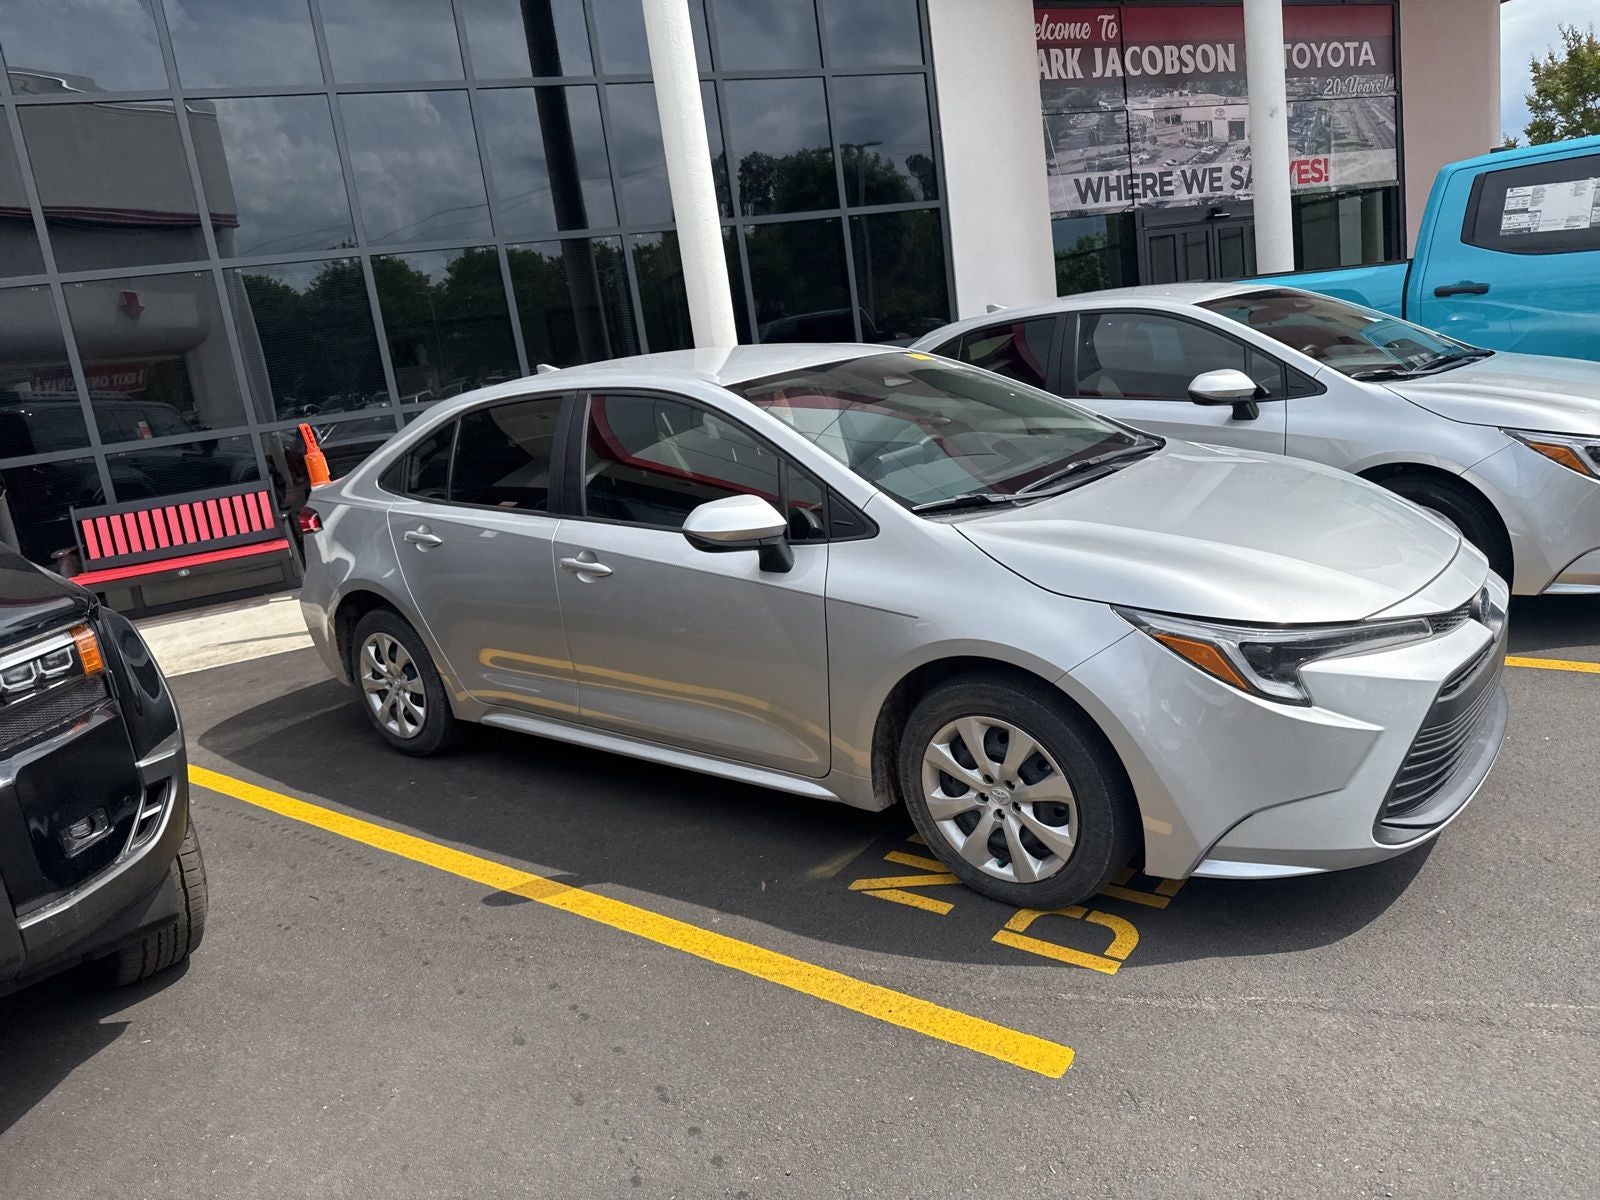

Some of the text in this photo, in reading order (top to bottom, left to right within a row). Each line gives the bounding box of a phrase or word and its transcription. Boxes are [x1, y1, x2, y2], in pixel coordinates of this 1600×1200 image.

[1035, 14, 1118, 41] elcome To
[1037, 48, 1084, 79] ARK
[1092, 44, 1236, 78] JACOBSON
[1074, 171, 1174, 204] WHERE
[1180, 167, 1223, 194] WE
